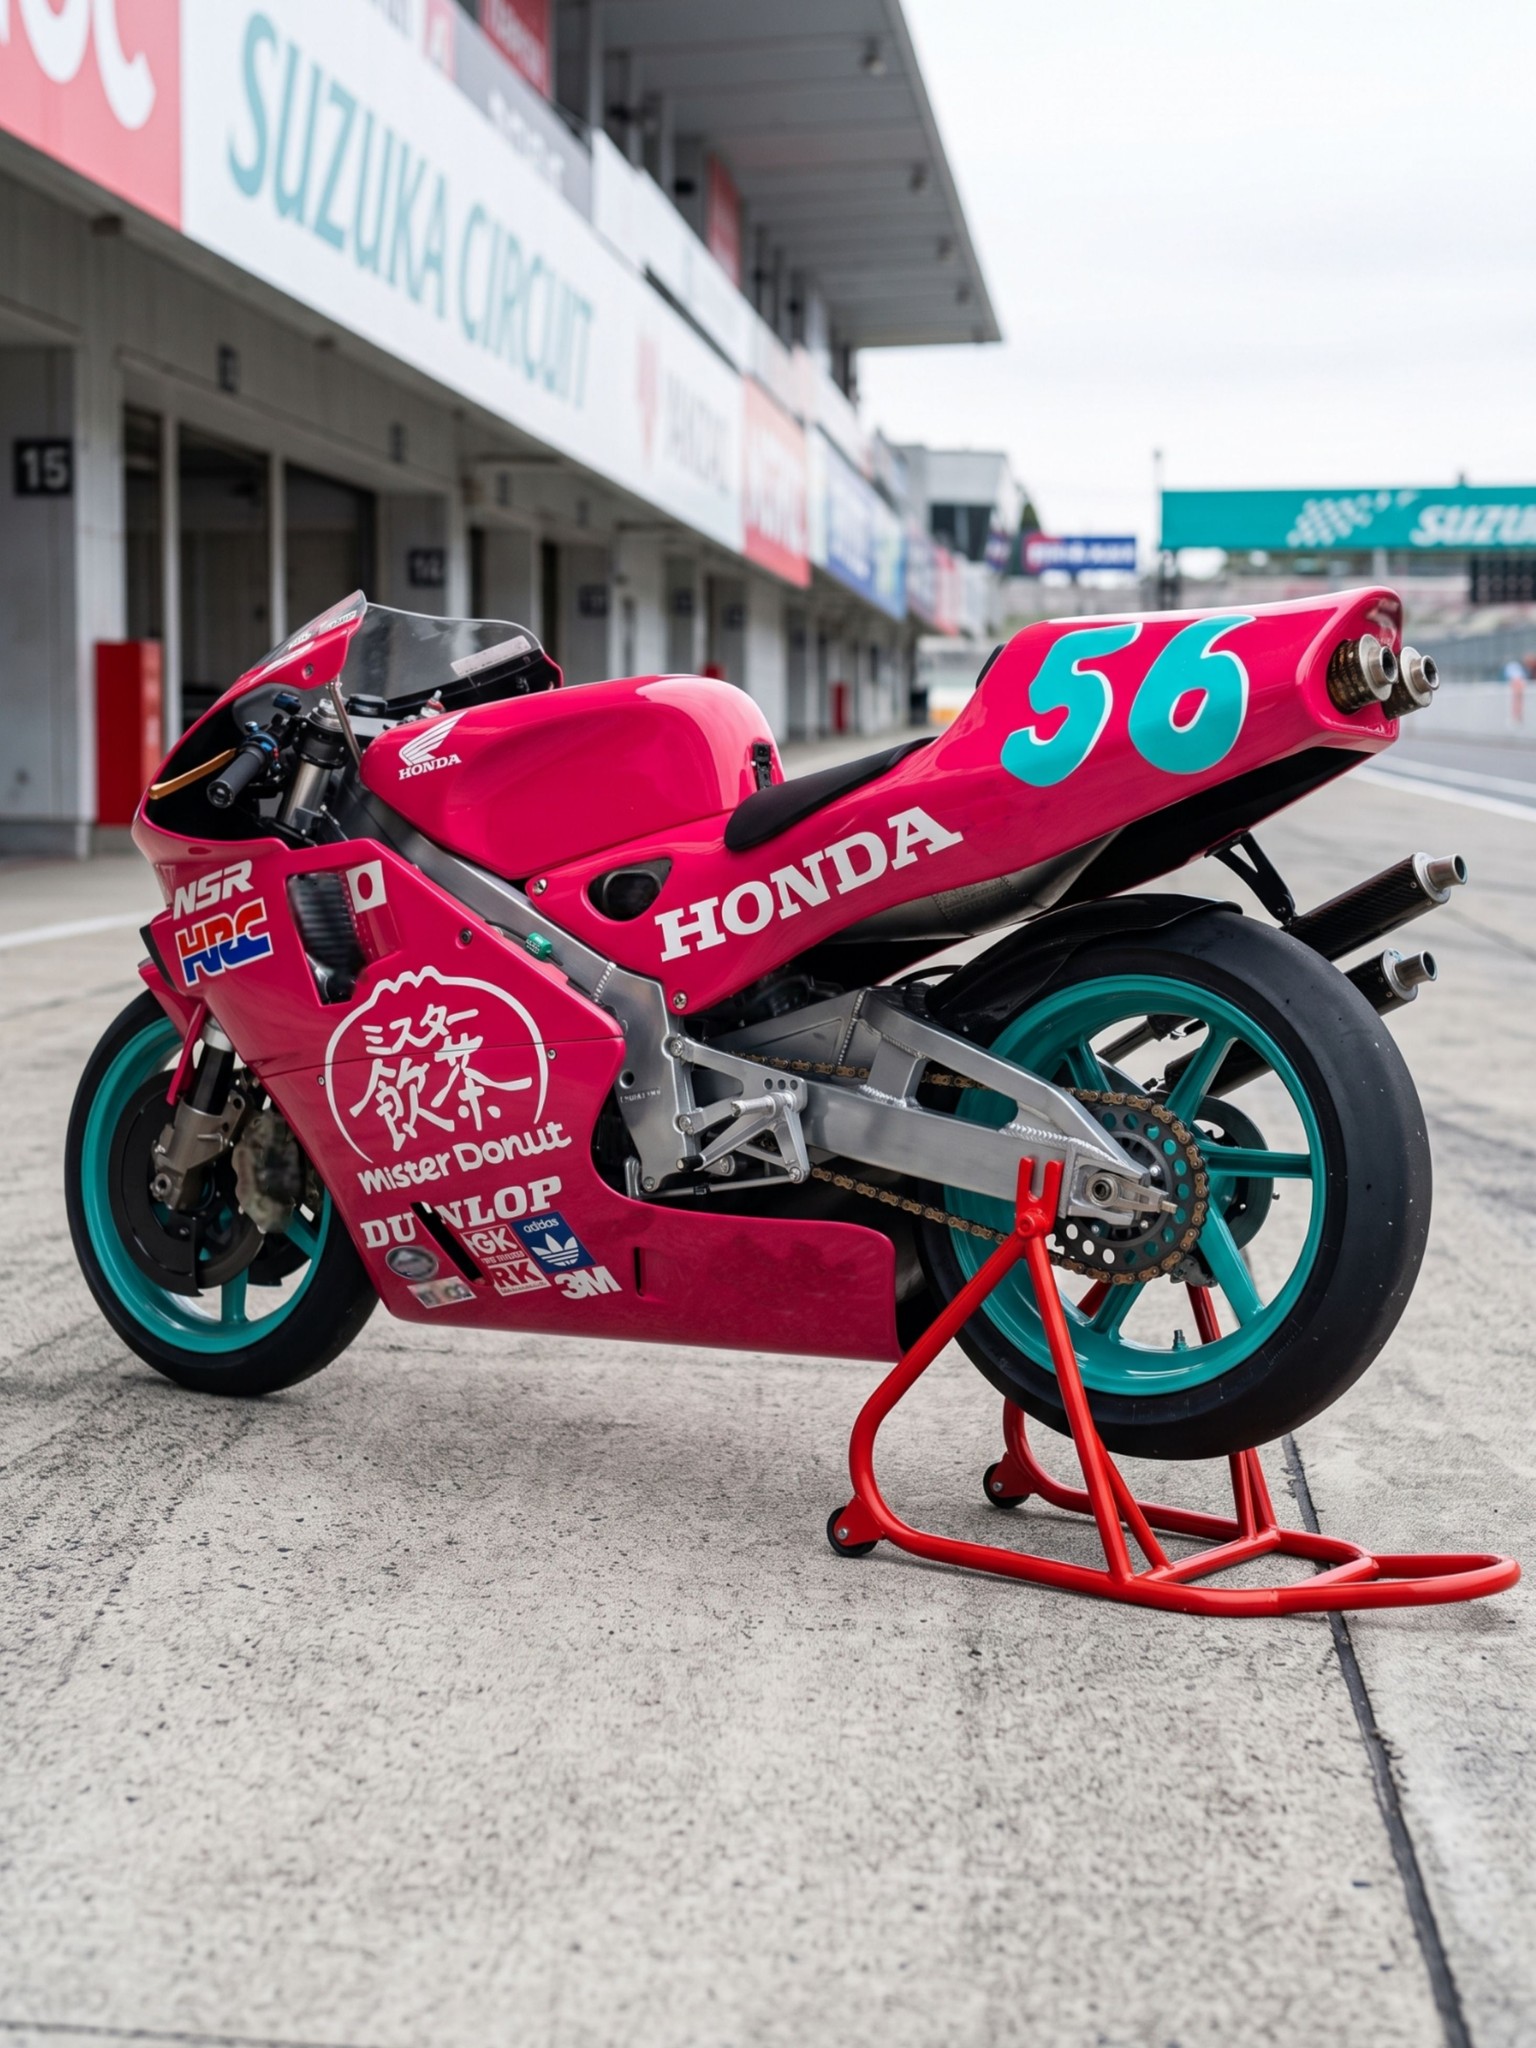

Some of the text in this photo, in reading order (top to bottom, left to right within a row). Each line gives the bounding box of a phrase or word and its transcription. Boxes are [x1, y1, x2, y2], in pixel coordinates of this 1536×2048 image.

[227, 12, 446, 320] SUZUKA
[459, 202, 594, 410] CIRCUIT
[23, 446, 67, 489] 15
[1000, 614, 1255, 787] 56
[398, 753, 462, 780] HONDA
[173, 859, 253, 920] NSR
[654, 806, 963, 963] HONDA
[175, 897, 274, 987] HRC
[362, 1003, 479, 1056] ミスター
[349, 1032, 533, 1152] 飲茶
[452, 1121, 573, 1172] Donut
[523, 1217, 560, 1234] adidas
[490, 1262, 543, 1289] RK
[554, 1266, 622, 1300] 3M
